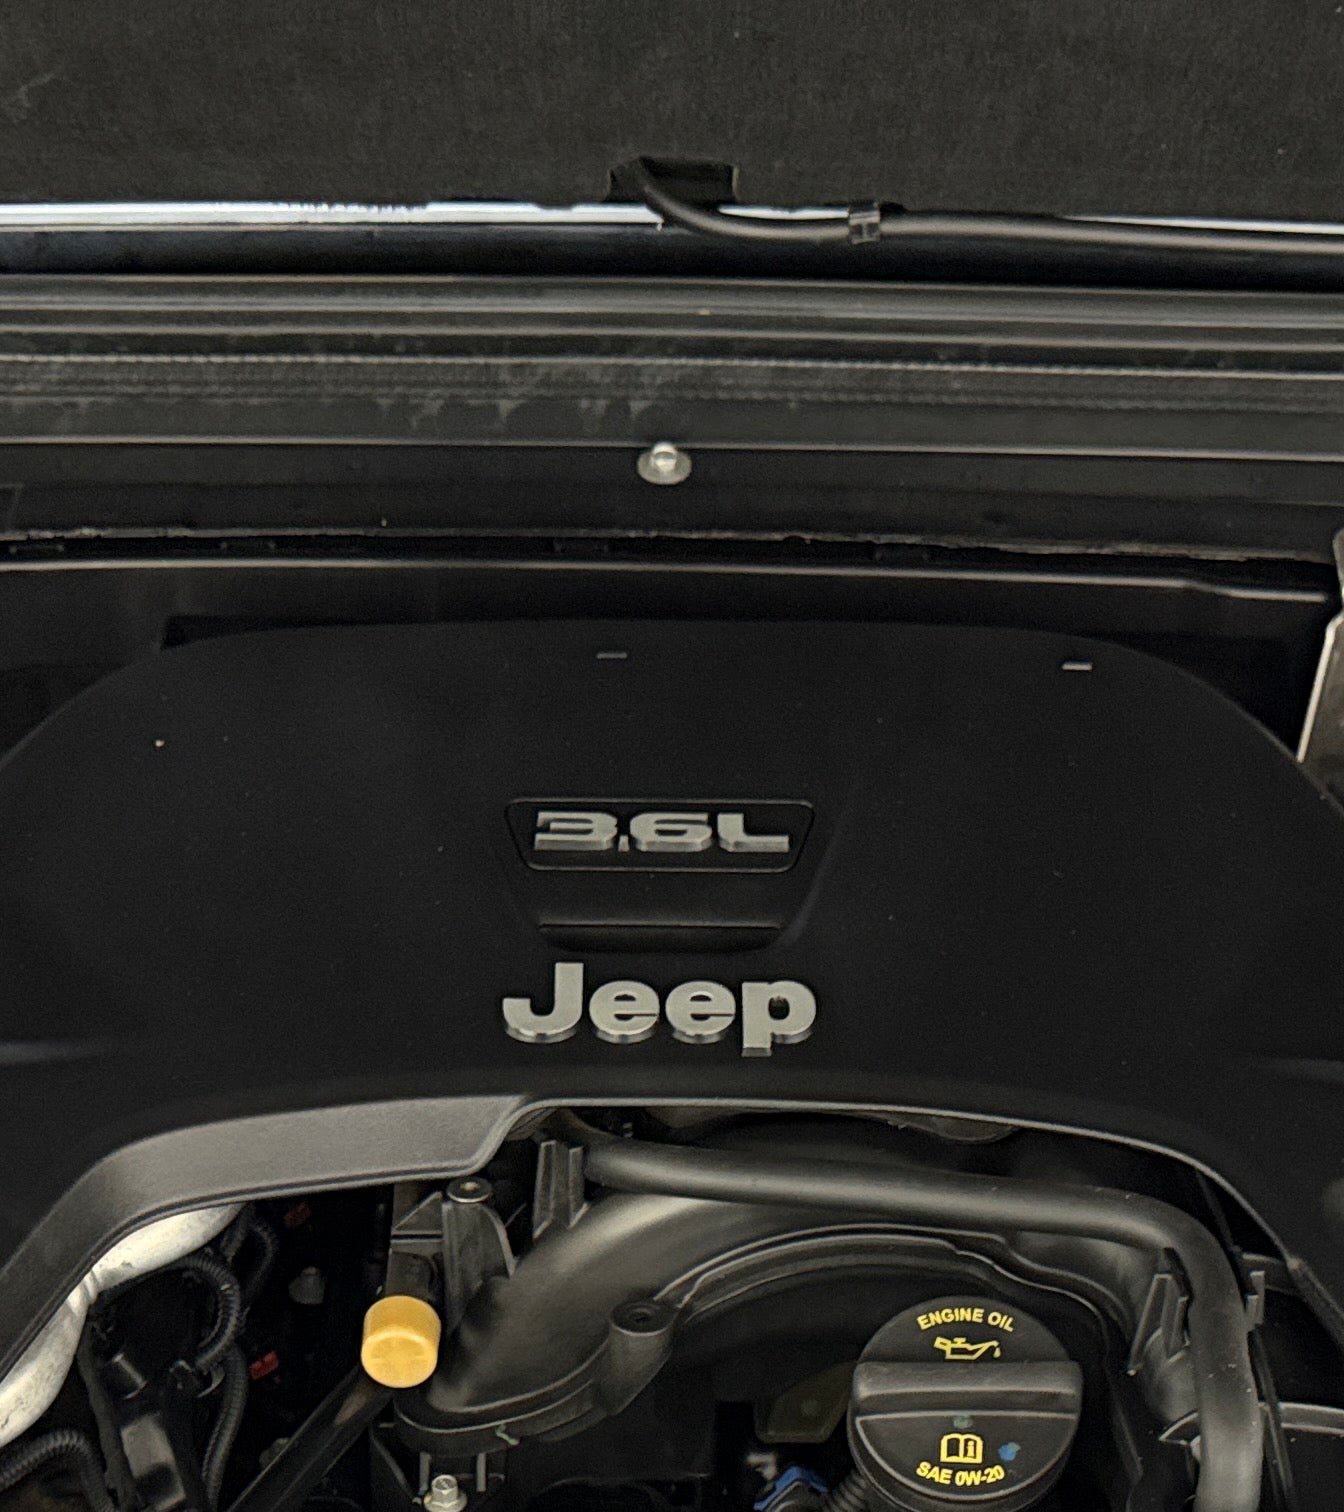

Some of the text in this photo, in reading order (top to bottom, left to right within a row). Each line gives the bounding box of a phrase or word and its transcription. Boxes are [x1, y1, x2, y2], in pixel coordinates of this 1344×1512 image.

[534, 811, 790, 853] 3.6L
[502, 962, 817, 1057] Jeep
[916, 1307, 1016, 1333] ENGINE OIL
[916, 1461, 1005, 1486] SAE 0W-20
